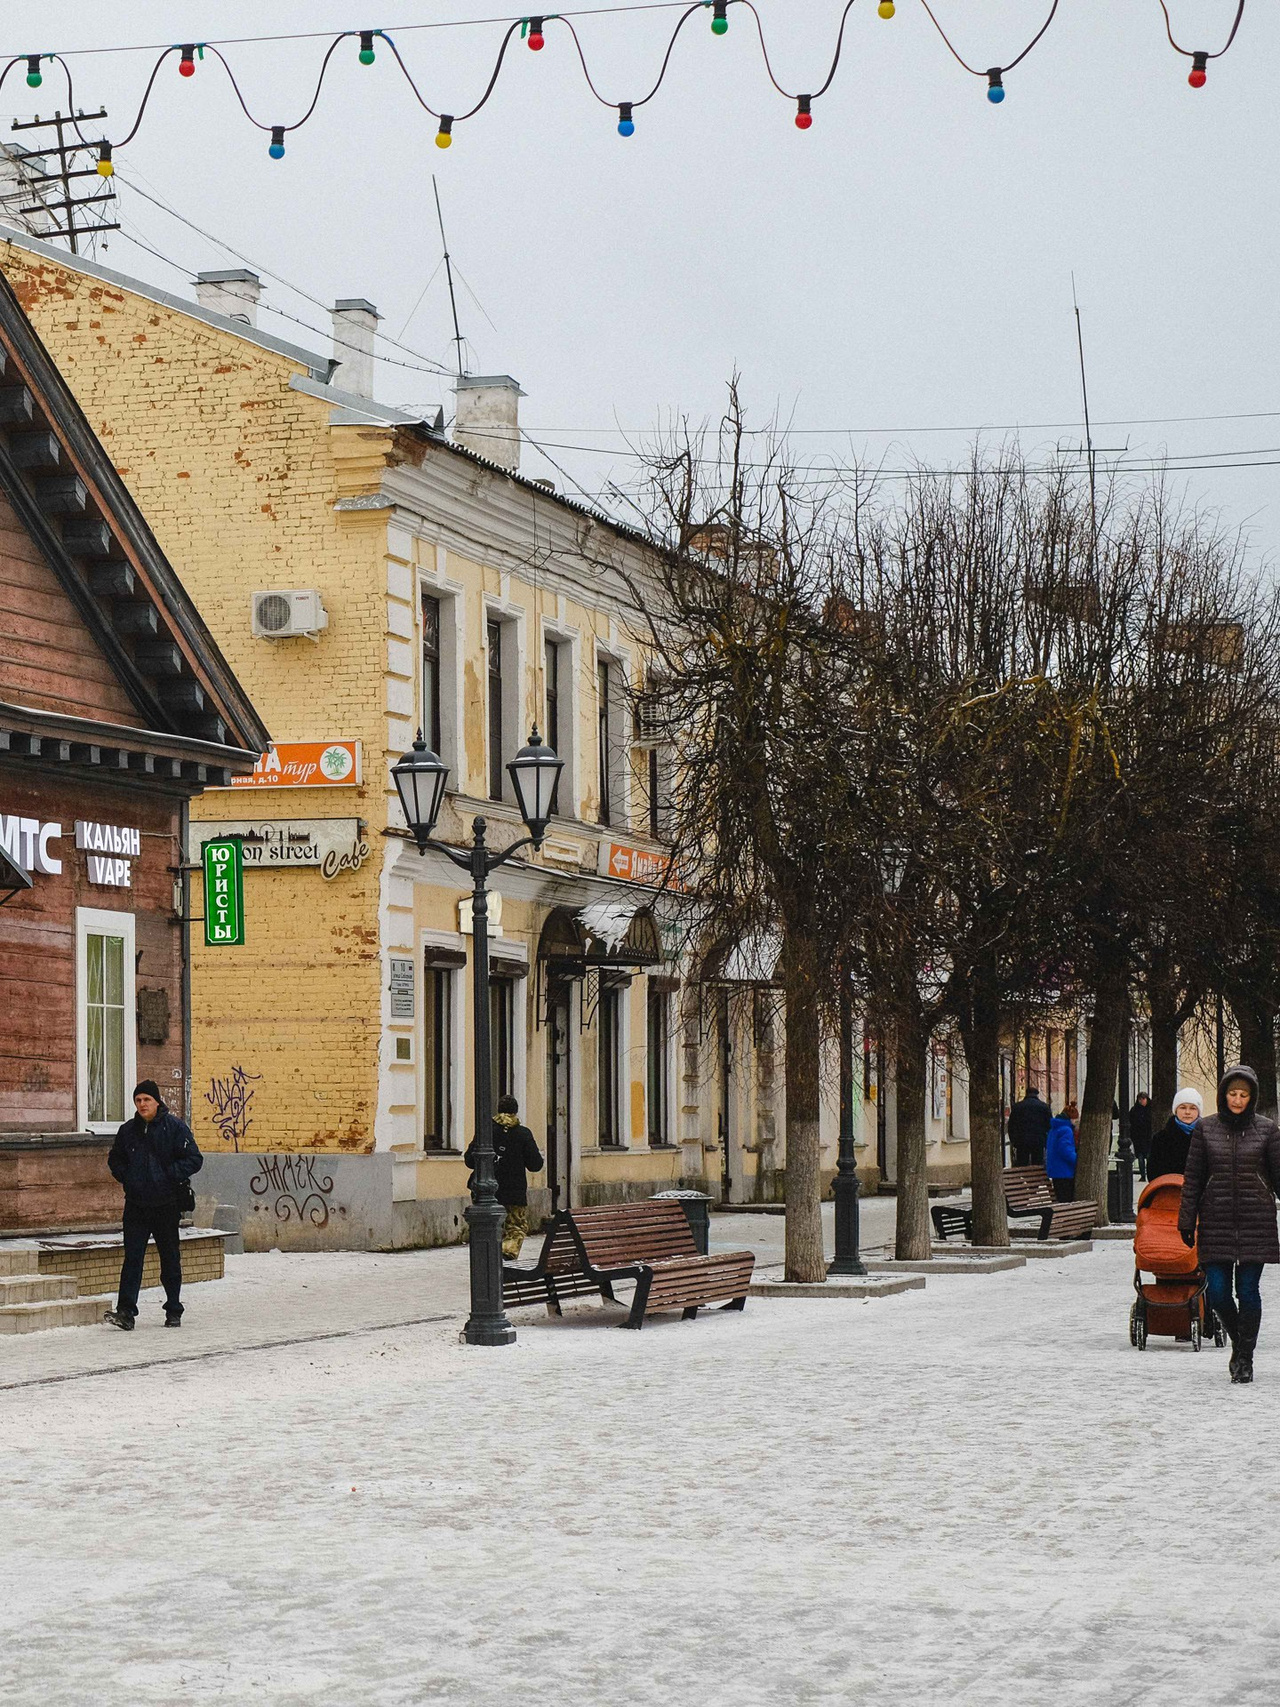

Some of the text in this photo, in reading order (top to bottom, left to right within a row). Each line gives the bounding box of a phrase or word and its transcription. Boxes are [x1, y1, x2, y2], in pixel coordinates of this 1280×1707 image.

[258, 774, 279, 785] д.10
[82, 821, 141, 856] КАЛЬЯН
[270, 843, 320, 861] street
[94, 856, 132, 887] VAPE
[322, 840, 369, 879] Cafe
[211, 848, 232, 939] ЮРИСТЫ
